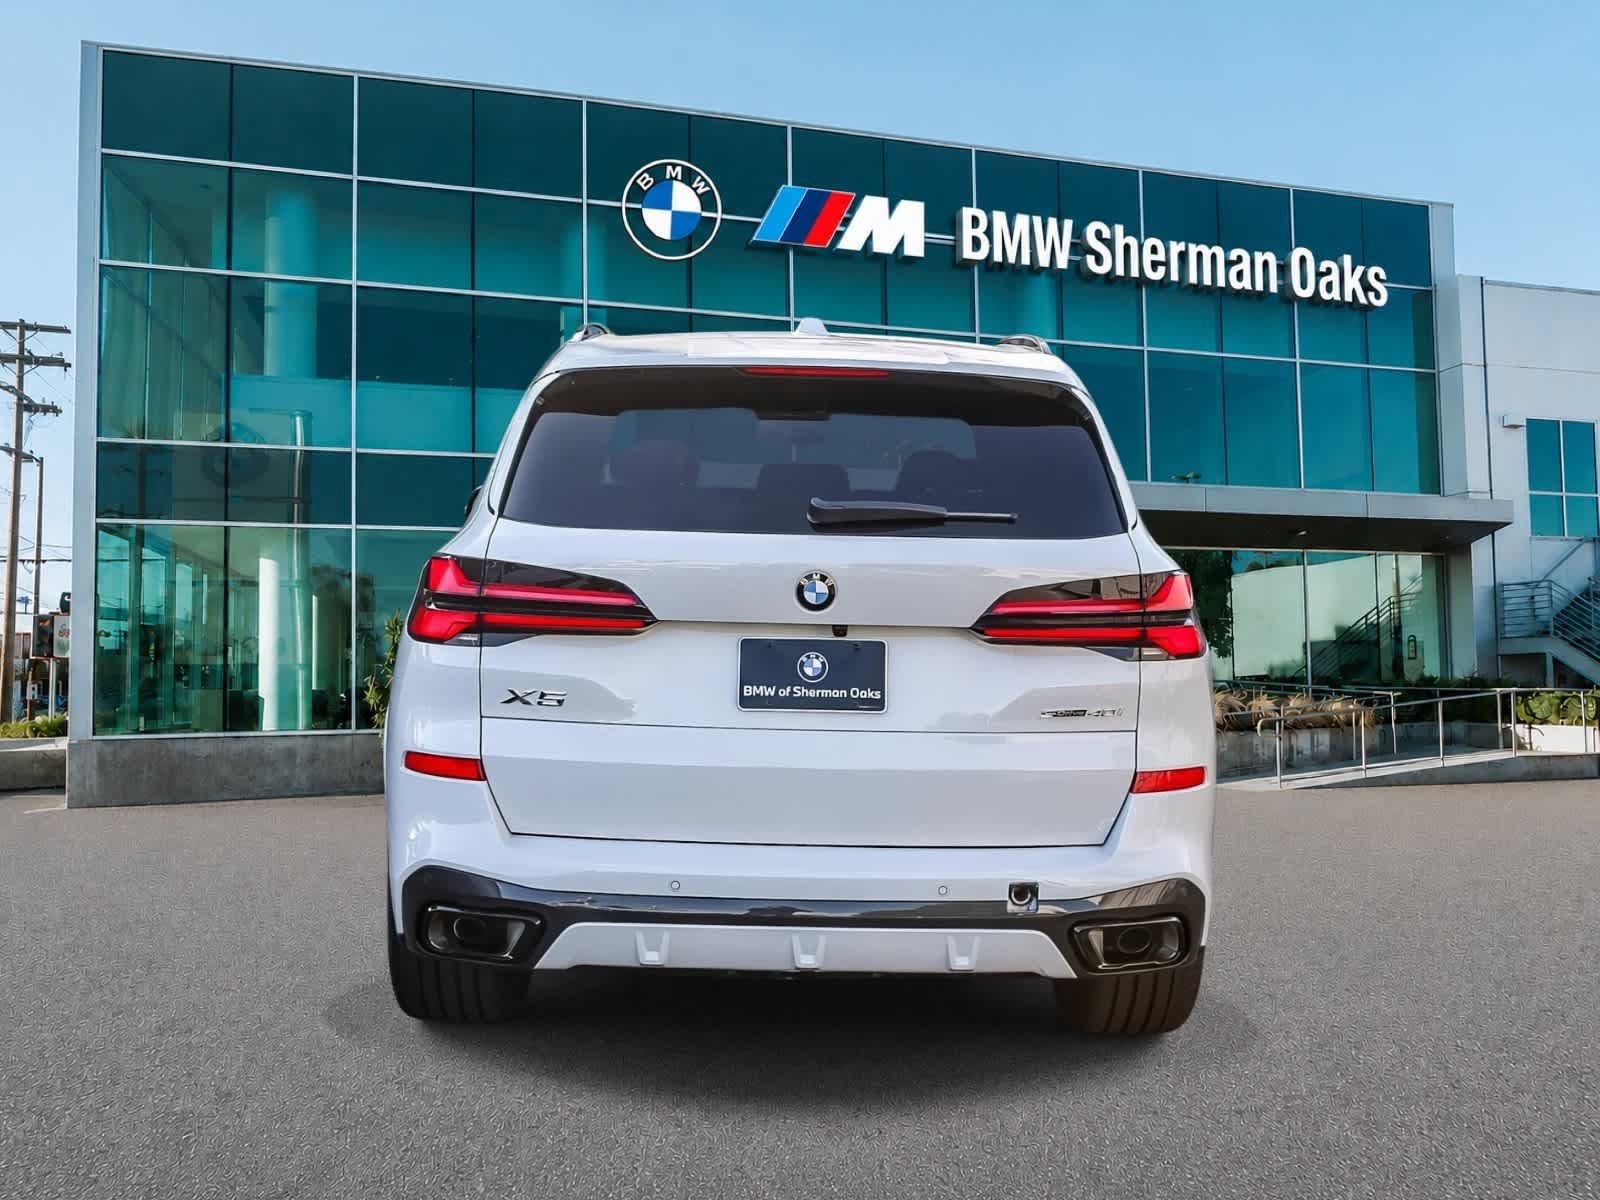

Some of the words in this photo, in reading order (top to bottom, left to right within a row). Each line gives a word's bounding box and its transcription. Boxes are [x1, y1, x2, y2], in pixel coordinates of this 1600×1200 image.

[636, 164, 711, 195] BMW
[834, 195, 925, 258] M
[960, 206, 1073, 270] BMW
[1084, 220, 1278, 294] Sherman
[1288, 247, 1389, 308] Oaks
[499, 688, 568, 707] X5
[743, 685, 776, 697] BMW
[779, 686, 791, 697] of
[792, 686, 847, 698] Sherman
[850, 687, 881, 699] Oaks
